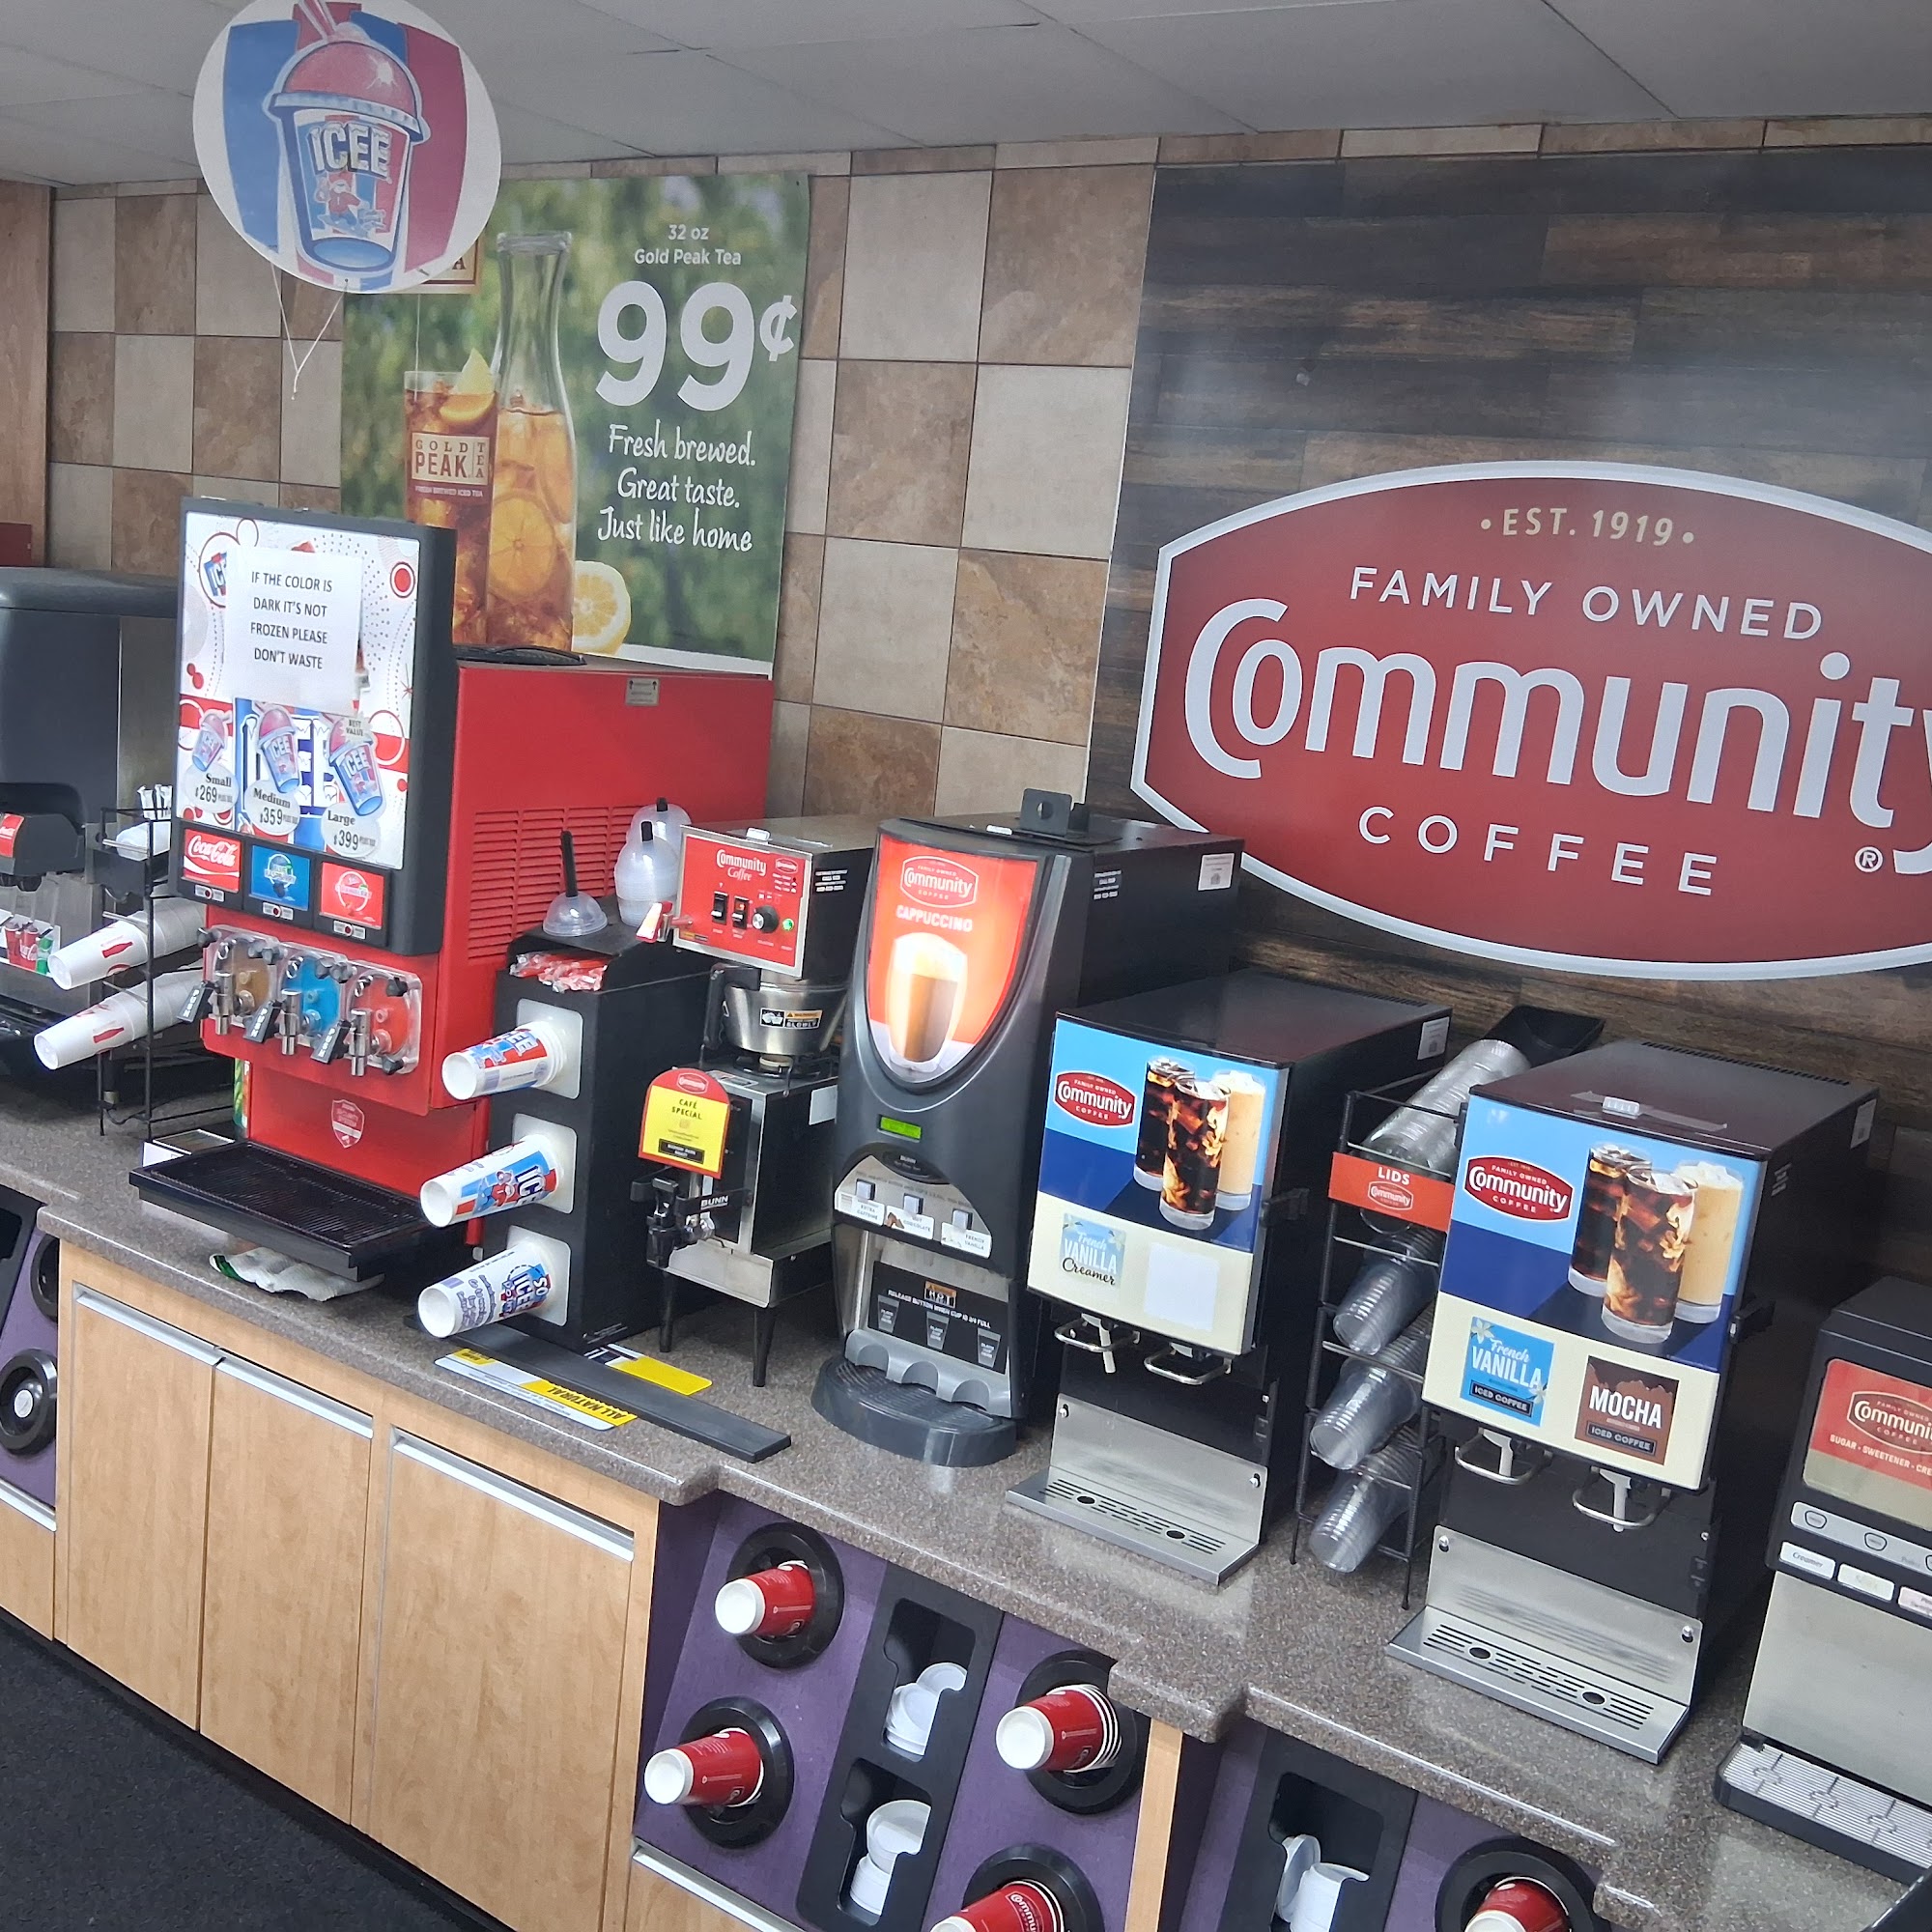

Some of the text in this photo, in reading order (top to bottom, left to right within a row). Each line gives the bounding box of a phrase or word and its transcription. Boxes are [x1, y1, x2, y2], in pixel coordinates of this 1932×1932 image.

[309, 122, 392, 180] ICEE
[668, 224, 710, 241] 32 oz
[634, 248, 742, 266] Gold Peak Tea
[415, 439, 469, 453] GOLD
[609, 418, 757, 467] Fresh brewed.
[415, 451, 468, 478] PEAK
[616, 467, 741, 508] Great taste.
[597, 506, 753, 553] Just like home
[1502, 505, 1675, 548] EST. 1919
[251, 571, 332, 592] IF THE COLOR IS
[253, 596, 328, 617] DARK IT'S NOT
[1349, 566, 1824, 640] FAMILY OWNED
[250, 621, 328, 644] FROZEN PLEASE
[254, 647, 323, 669] DON'T WASTE
[205, 772, 232, 788] Small
[253, 787, 291, 809] Medium
[327, 810, 355, 826] Large
[716, 848, 767, 877] Community
[1357, 805, 1719, 897] COFFEE
[726, 867, 753, 881] Coffee
[903, 867, 973, 898] Community
[895, 904, 974, 932] CAPPUCCINO
[1057, 1080, 1132, 1120] Community
[671, 1106, 702, 1121] SPECIAL
[1378, 1166, 1410, 1185] LIDS
[1491, 1164, 1518, 1177] FAMILY
[1519, 1173, 1547, 1185] OWNED
[700, 1195, 729, 1208] BUNN
[1370, 1185, 1410, 1207] Community
[1468, 1166, 1568, 1213] Community
[1492, 1195, 1537, 1213] COFFEE
[1064, 1237, 1118, 1275] VANILLA
[1062, 1257, 1116, 1286] Creamer
[1490, 1337, 1530, 1363] French
[1472, 1345, 1543, 1389] VANILLA
[546, 1386, 604, 1411] NATURAL
[1474, 1385, 1494, 1399] ICED
[1494, 1393, 1528, 1411] COFFEE
[1588, 1385, 1662, 1430] MOCHA
[600, 1407, 627, 1420] ALL
[1591, 1426, 1651, 1451] ICED COFFEE
[1829, 1434, 1858, 1450] SUGAR
[1861, 1445, 1912, 1468] SWEETENER
